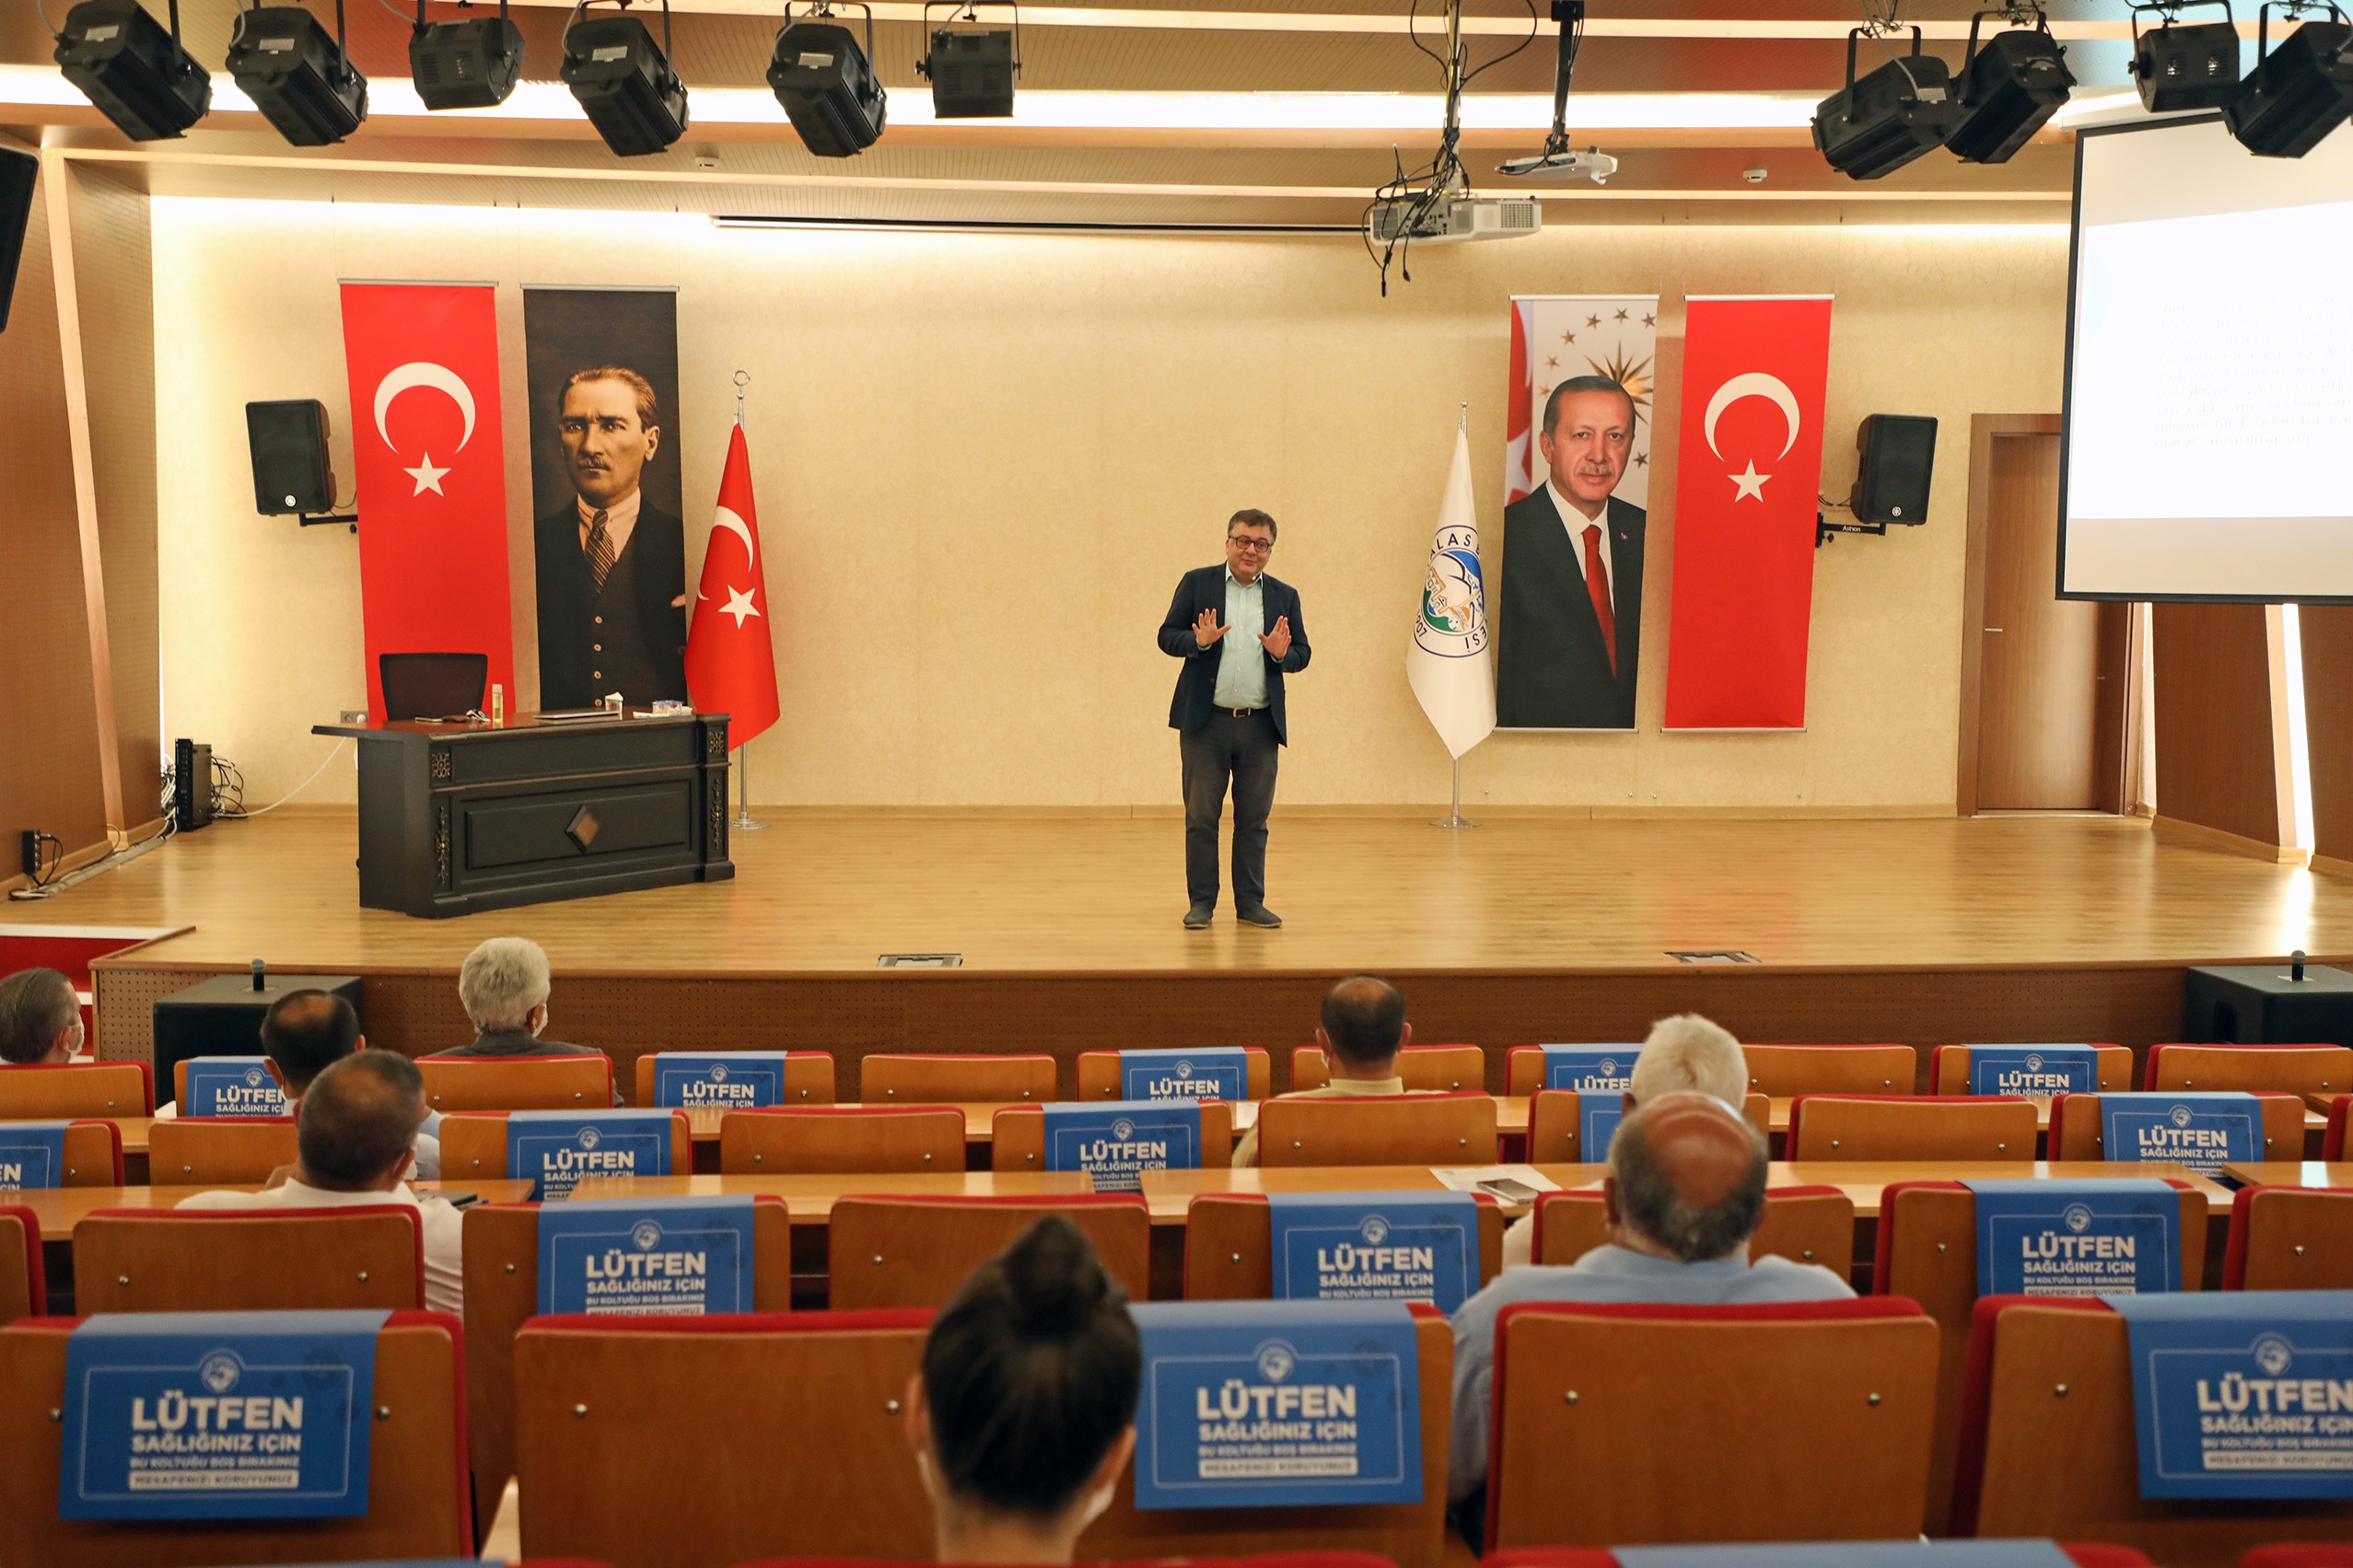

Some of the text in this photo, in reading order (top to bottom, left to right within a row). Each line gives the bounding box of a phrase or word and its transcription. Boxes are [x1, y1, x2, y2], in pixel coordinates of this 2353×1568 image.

[1149, 1077, 1219, 1095] LÜTFEN
[1998, 1070, 2069, 1088] LÜTFEN
[682, 1080, 754, 1098] LÜTFEN
[1999, 1087, 2049, 1096] SAĞLIĞINIZ
[215, 1103, 284, 1113] SAĞLIĞINIZ İÇİ
[683, 1098, 754, 1109] SAĞLIĞINIZ İÇİN
[2138, 1125, 2228, 1147] LÜTFEN
[543, 1148, 635, 1170] LÜTFEN
[1079, 1140, 1167, 1161] LÜTFEN
[2140, 1146, 2228, 1160] SAĞLIĞINIZ İÇİN
[1081, 1161, 1142, 1172] SAĞLIĞINIZ
[2022, 1231, 2135, 1258] LÜTFEN
[586, 1249, 705, 1278] LÜTFEN
[1318, 1244, 1433, 1272] LÜTFEN
[2023, 1259, 2136, 1274] SAĞLIĞINIZ İÇİN
[587, 1278, 705, 1295] SAĞLIĞINIZ İÇİN
[1319, 1272, 1434, 1287] SAĞLIĞINIZ İÇİN
[587, 1296, 600, 1306] BU
[1197, 1379, 1357, 1420] LÜTFEN
[2196, 1372, 2353, 1411] LÜTFEN
[132, 1388, 303, 1431] LÜTFEN
[1199, 1420, 1357, 1442] SAĞLIĞINIZ İÇİN
[2201, 1413, 2314, 1434] SAĞLIĞINIZ
[132, 1432, 301, 1455] SAĞLIĞINIZ İÇİN
